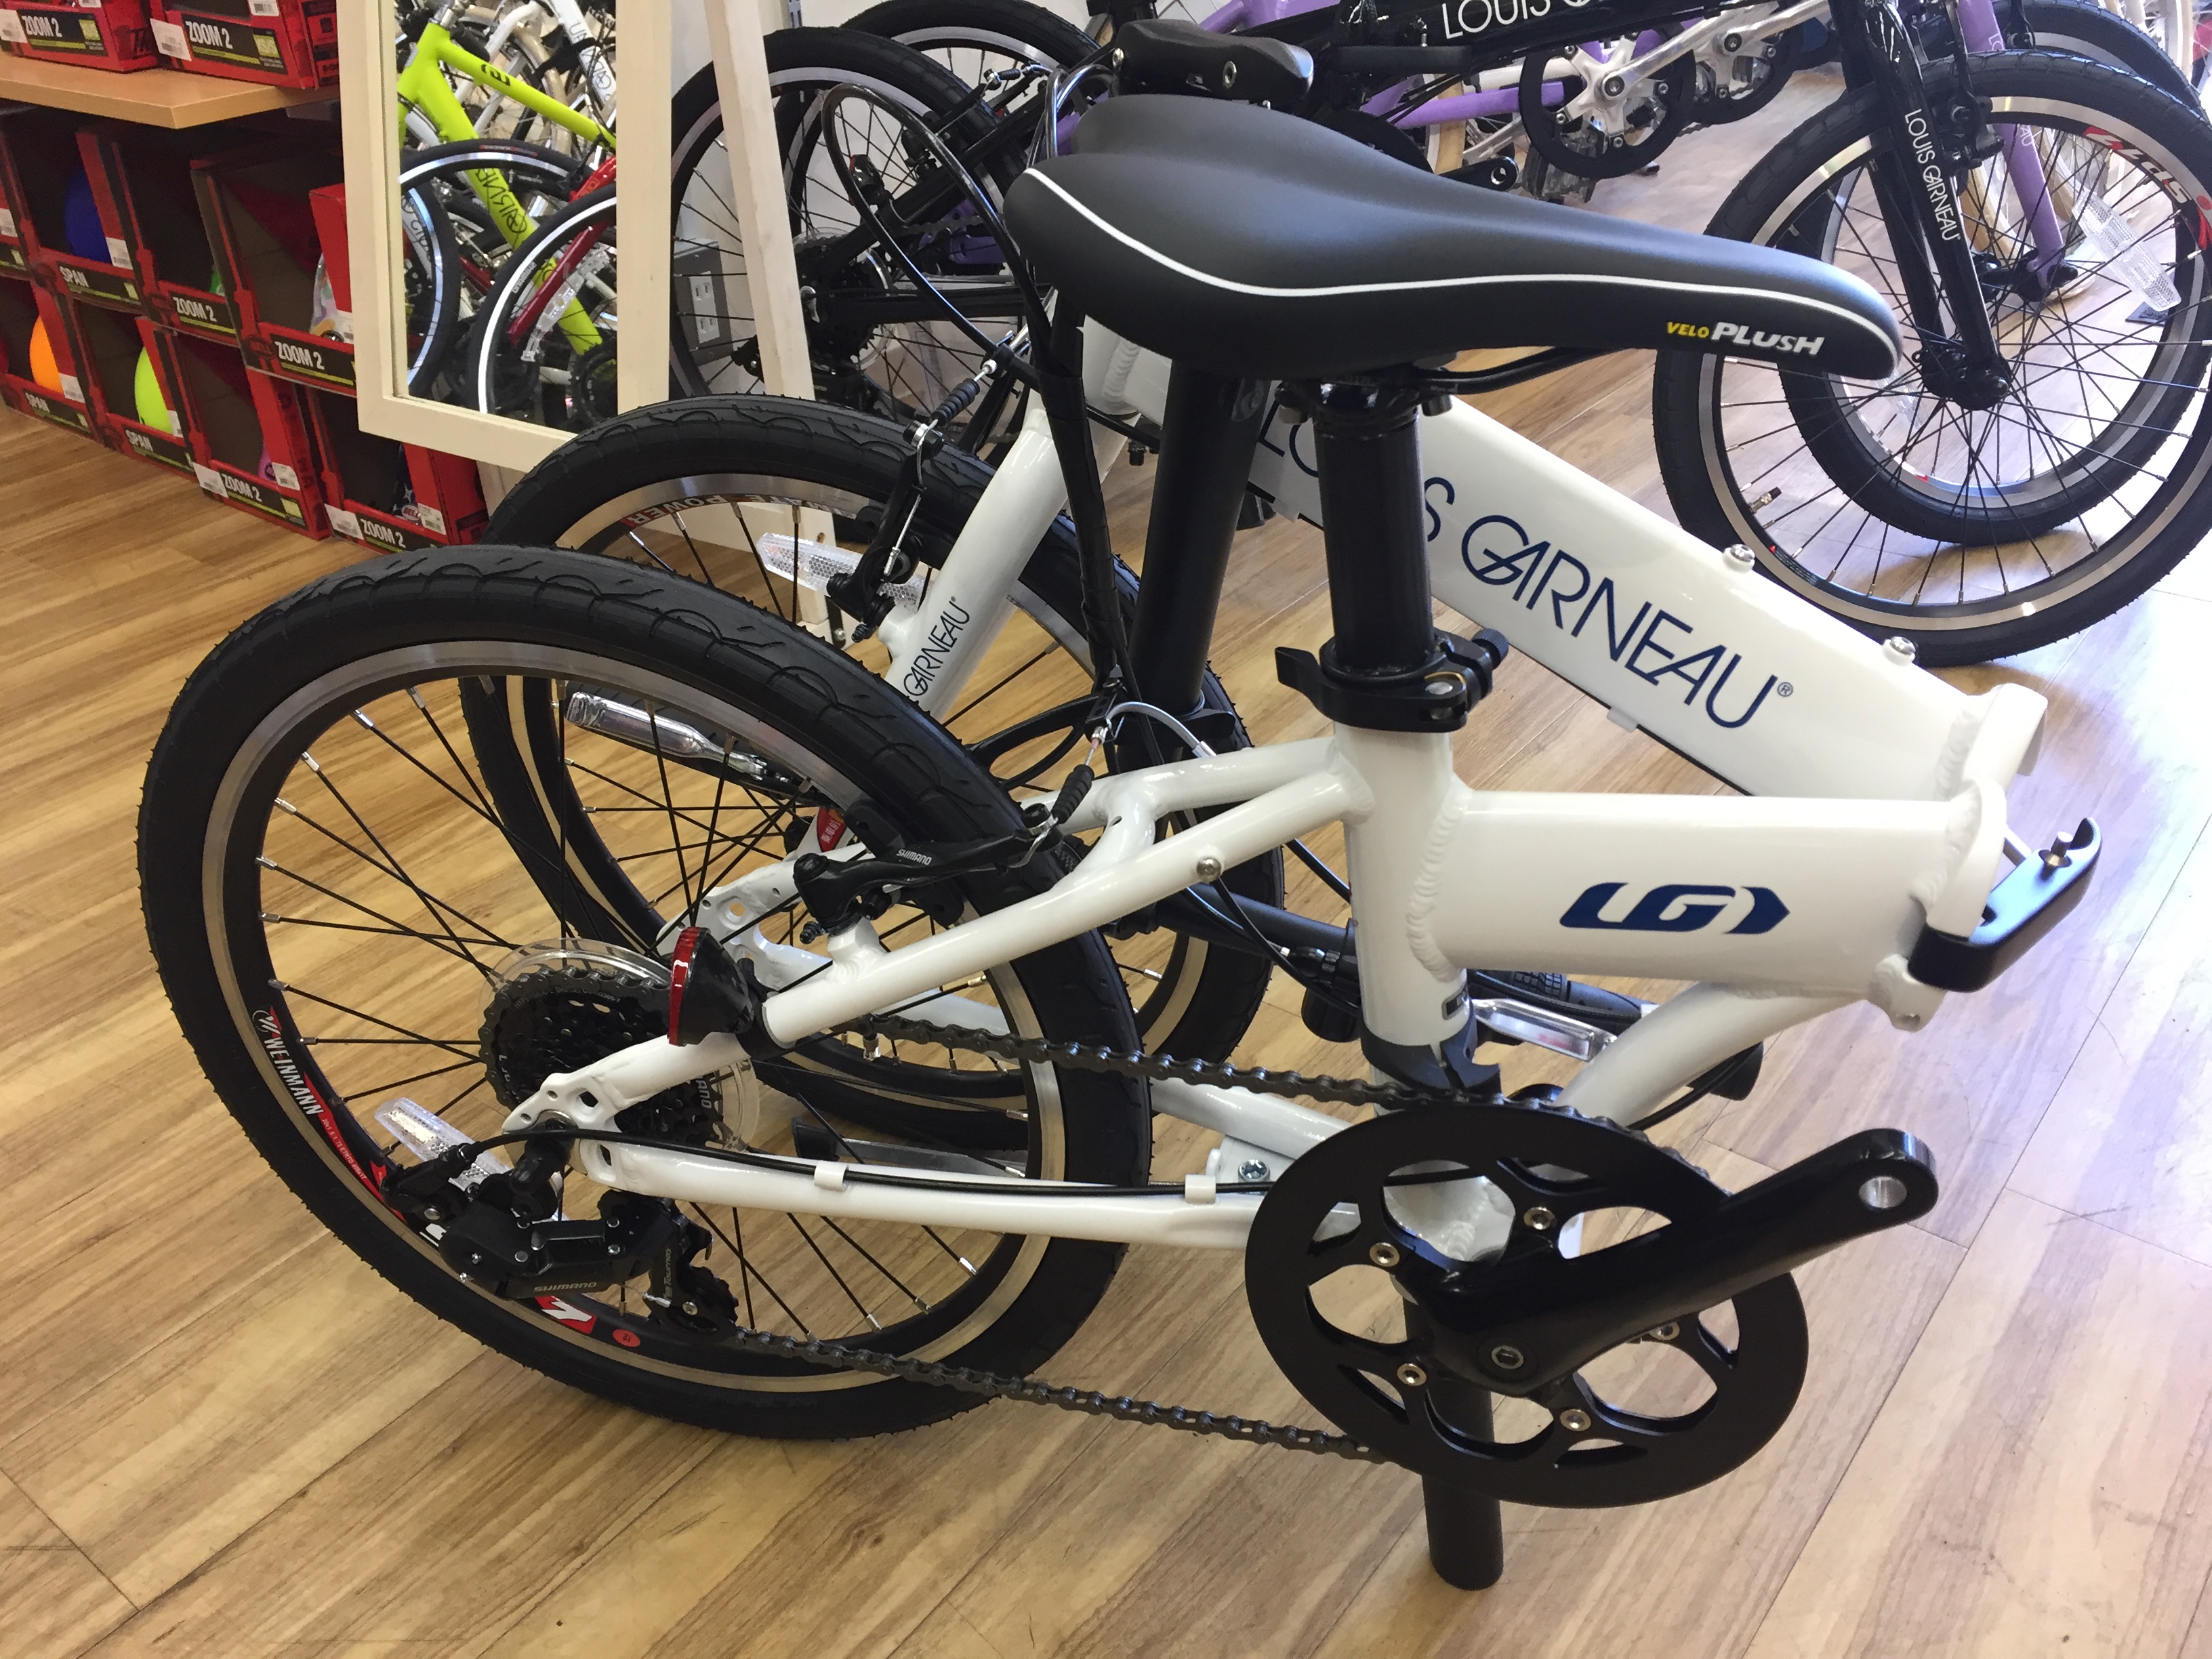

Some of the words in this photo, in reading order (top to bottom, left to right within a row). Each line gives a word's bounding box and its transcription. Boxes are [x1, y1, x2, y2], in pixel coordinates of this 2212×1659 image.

[21, 15, 54, 37] ZOOM
[52, 18, 63, 38] 2
[185, 21, 223, 47] ZOOM
[222, 28, 233, 49] 2
[1904, 108, 1936, 163] LOUIS
[60, 266, 89, 287] SPAN
[172, 296, 207, 320] ZOOM
[205, 305, 217, 322] 2
[1666, 321, 1710, 339] VELO
[1711, 321, 1825, 356] PLUSH
[274, 341, 313, 367] ZOOM
[313, 351, 325, 370] 2
[221, 473, 253, 499] ZOOM
[252, 486, 262, 502] 2
[627, 495, 726, 525] POWER
[360, 518, 395, 546] ZOOM
[396, 533, 406, 548] 2
[896, 848, 933, 865] SHIMANO
[264, 1038, 324, 1115] WEINMANN
[533, 1281, 597, 1293] SHIMANO
